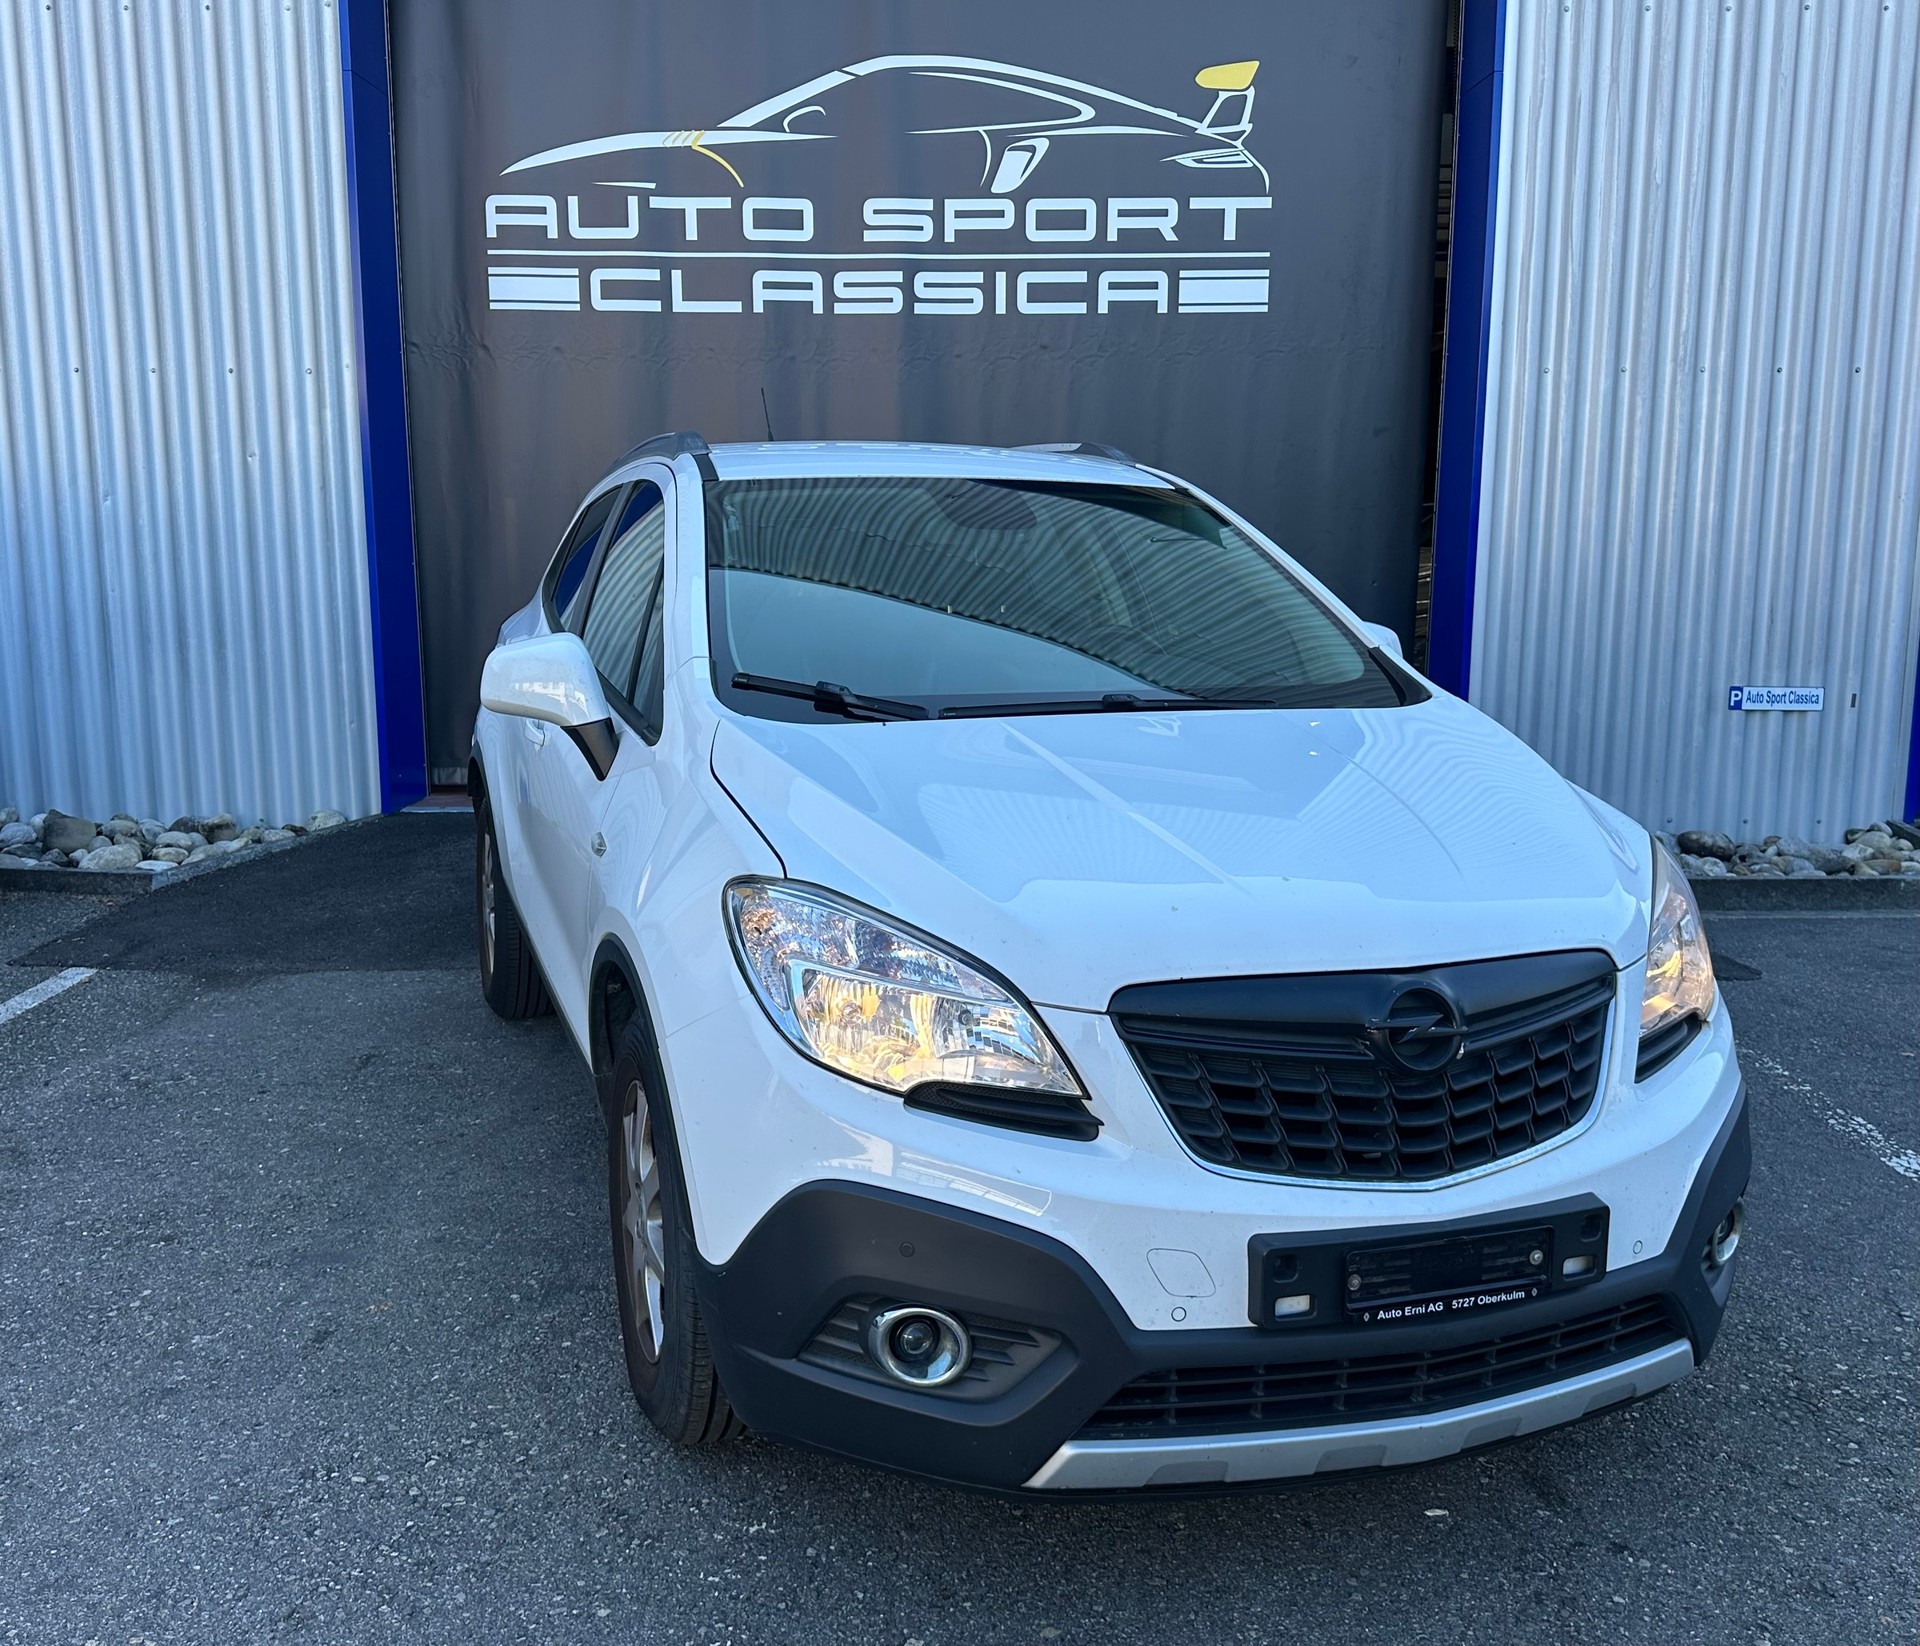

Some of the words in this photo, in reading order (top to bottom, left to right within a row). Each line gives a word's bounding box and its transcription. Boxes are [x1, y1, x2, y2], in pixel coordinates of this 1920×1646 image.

[486, 195, 814, 242] AUTO
[863, 196, 1273, 243] SPORT
[590, 268, 1169, 315] CLASSICA
[1730, 690, 1742, 707] P
[1745, 690, 1765, 704] Auto
[1765, 690, 1787, 707] Sport
[1788, 691, 1820, 705] Classica
[1377, 1310, 1403, 1320] Auto
[1404, 1304, 1426, 1316] Erni
[1427, 1301, 1444, 1313] AG
[1451, 1297, 1475, 1309] 5727
[1477, 1290, 1525, 1305] Oberkulm
